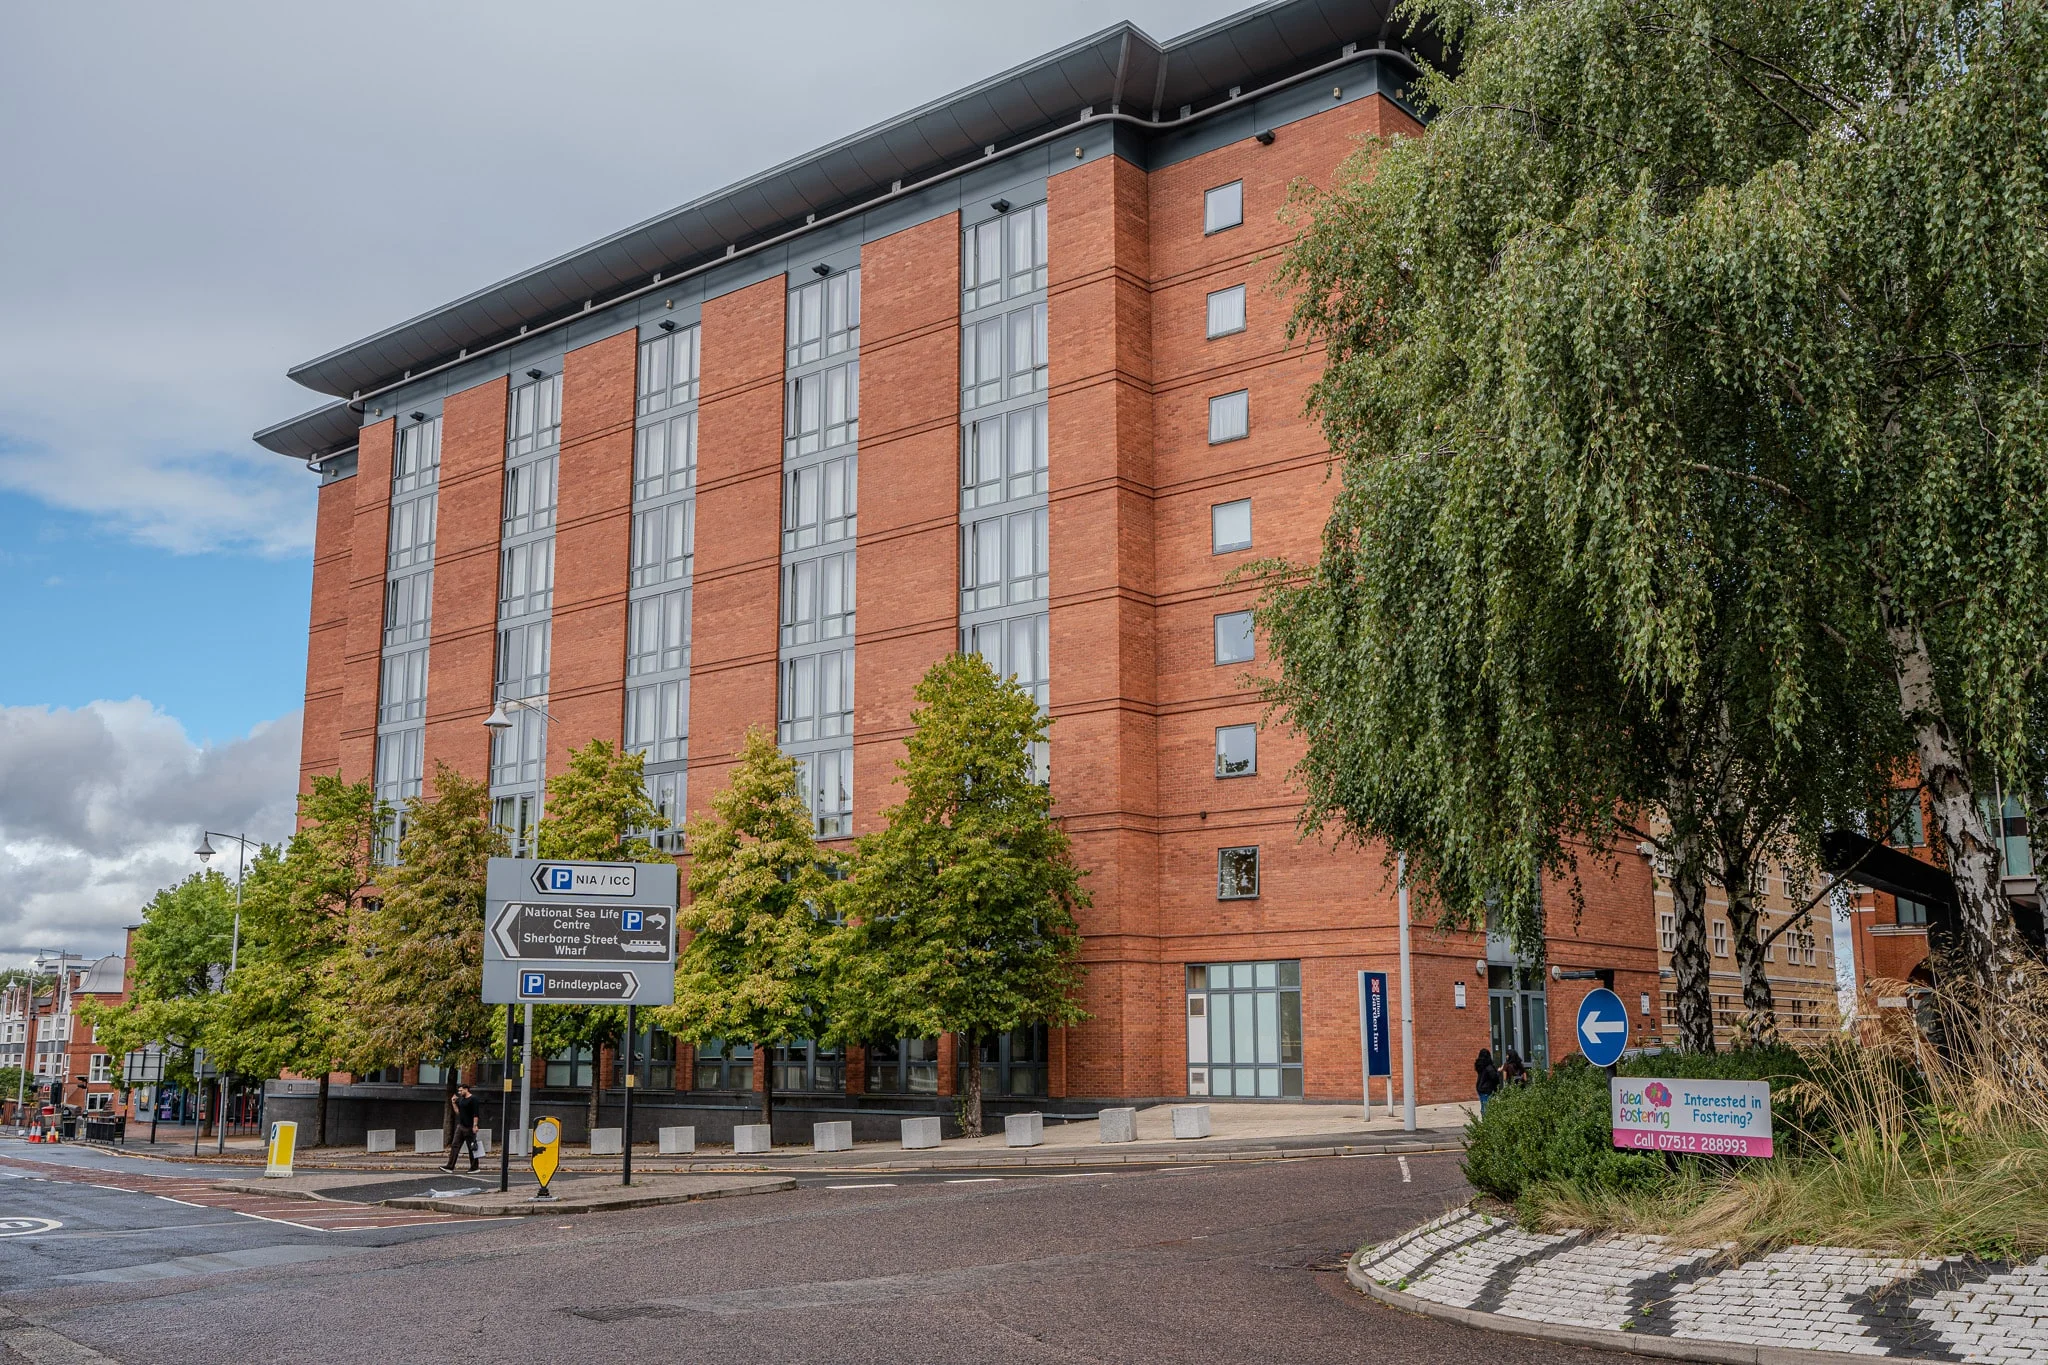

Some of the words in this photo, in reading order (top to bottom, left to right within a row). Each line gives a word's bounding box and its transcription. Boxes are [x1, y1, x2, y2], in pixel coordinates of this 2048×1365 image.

[557, 871, 570, 888] P
[576, 874, 597, 885] NIA
[600, 875, 606, 886] /
[609, 876, 630, 886] ICC
[525, 907, 572, 918] National
[575, 908, 596, 918] Sea
[600, 909, 619, 919] Life
[627, 912, 640, 929] P
[553, 919, 590, 930] Centre
[523, 933, 580, 944] Sherborne
[583, 934, 618, 945] Street
[555, 945, 588, 955] Wharf
[528, 975, 542, 993] P
[548, 979, 622, 991] Brindleyplace
[1619, 1089, 1644, 1105] ideal
[1684, 1093, 1746, 1109] Interested
[1751, 1095, 1762, 1109] in
[1620, 1107, 1670, 1129] fostering
[1693, 1109, 1753, 1129] Fostering?
[1634, 1133, 1654, 1147] Call
[1658, 1135, 1696, 1150] 07512
[1701, 1137, 1748, 1154] 288993
